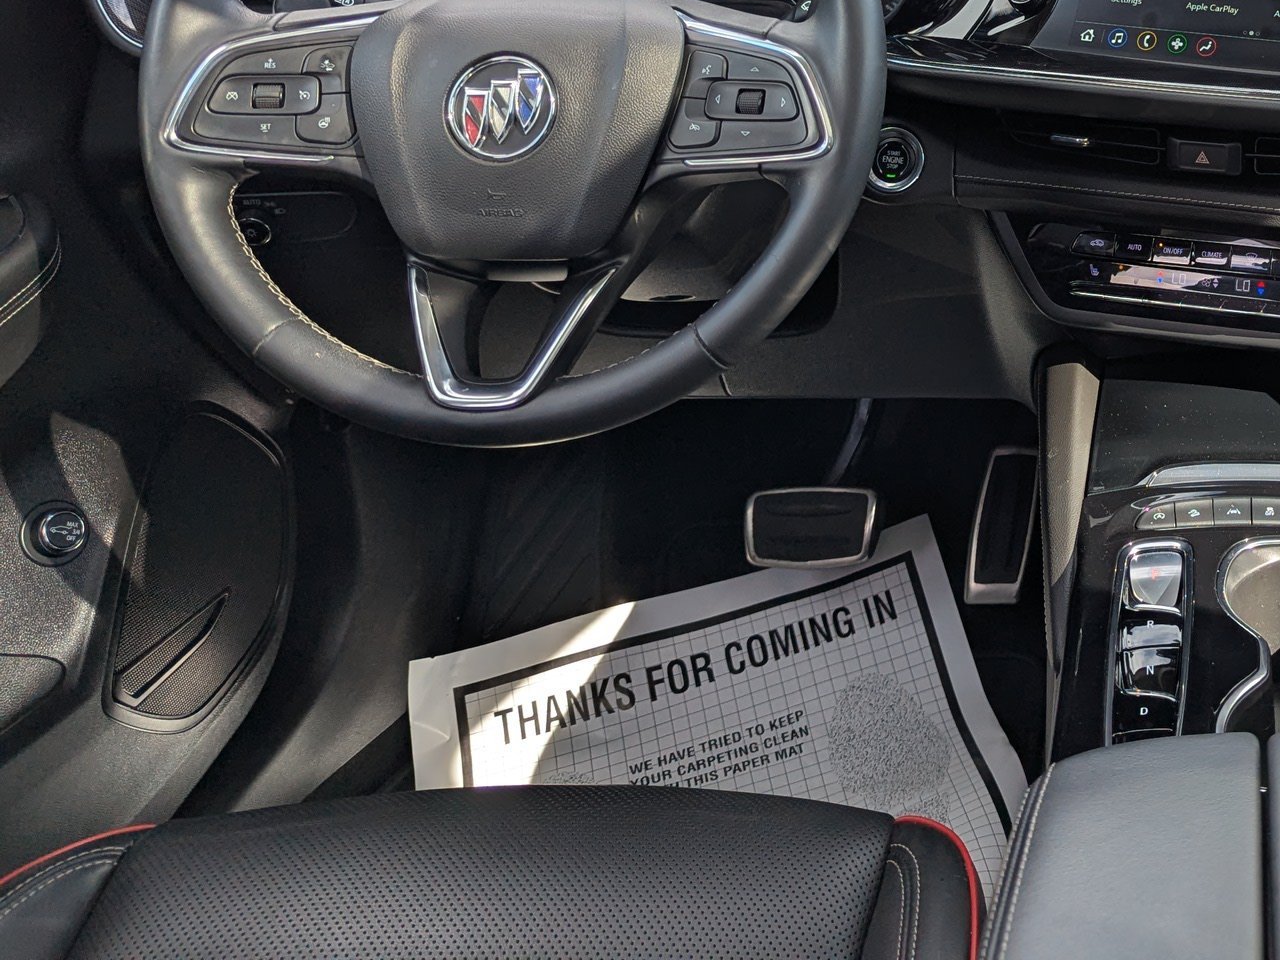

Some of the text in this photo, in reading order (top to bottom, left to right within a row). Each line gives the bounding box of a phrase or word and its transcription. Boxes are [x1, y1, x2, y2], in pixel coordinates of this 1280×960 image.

[1186, 2, 1239, 16] Apple CarPlay
[264, 61, 276, 69] RES
[260, 123, 271, 131] SET
[882, 155, 904, 164] ENGINE
[1127, 243, 1142, 251] AUTO
[1162, 246, 1183, 255] ON/OFF
[1201, 250, 1222, 258] CLIMATE
[1235, 279, 1250, 292] LO
[1147, 621, 1154, 629] R
[493, 590, 899, 747] THANKS FOR COMING IN
[1146, 666, 1154, 675] N
[1140, 707, 1149, 716] D
[629, 710, 804, 776] WE HAVE TRIED TO KEEP
[677, 742, 759, 776] CARPETING
[764, 725, 810, 749] CLEAN
[684, 743, 805, 788] THIS PAPER MAT
